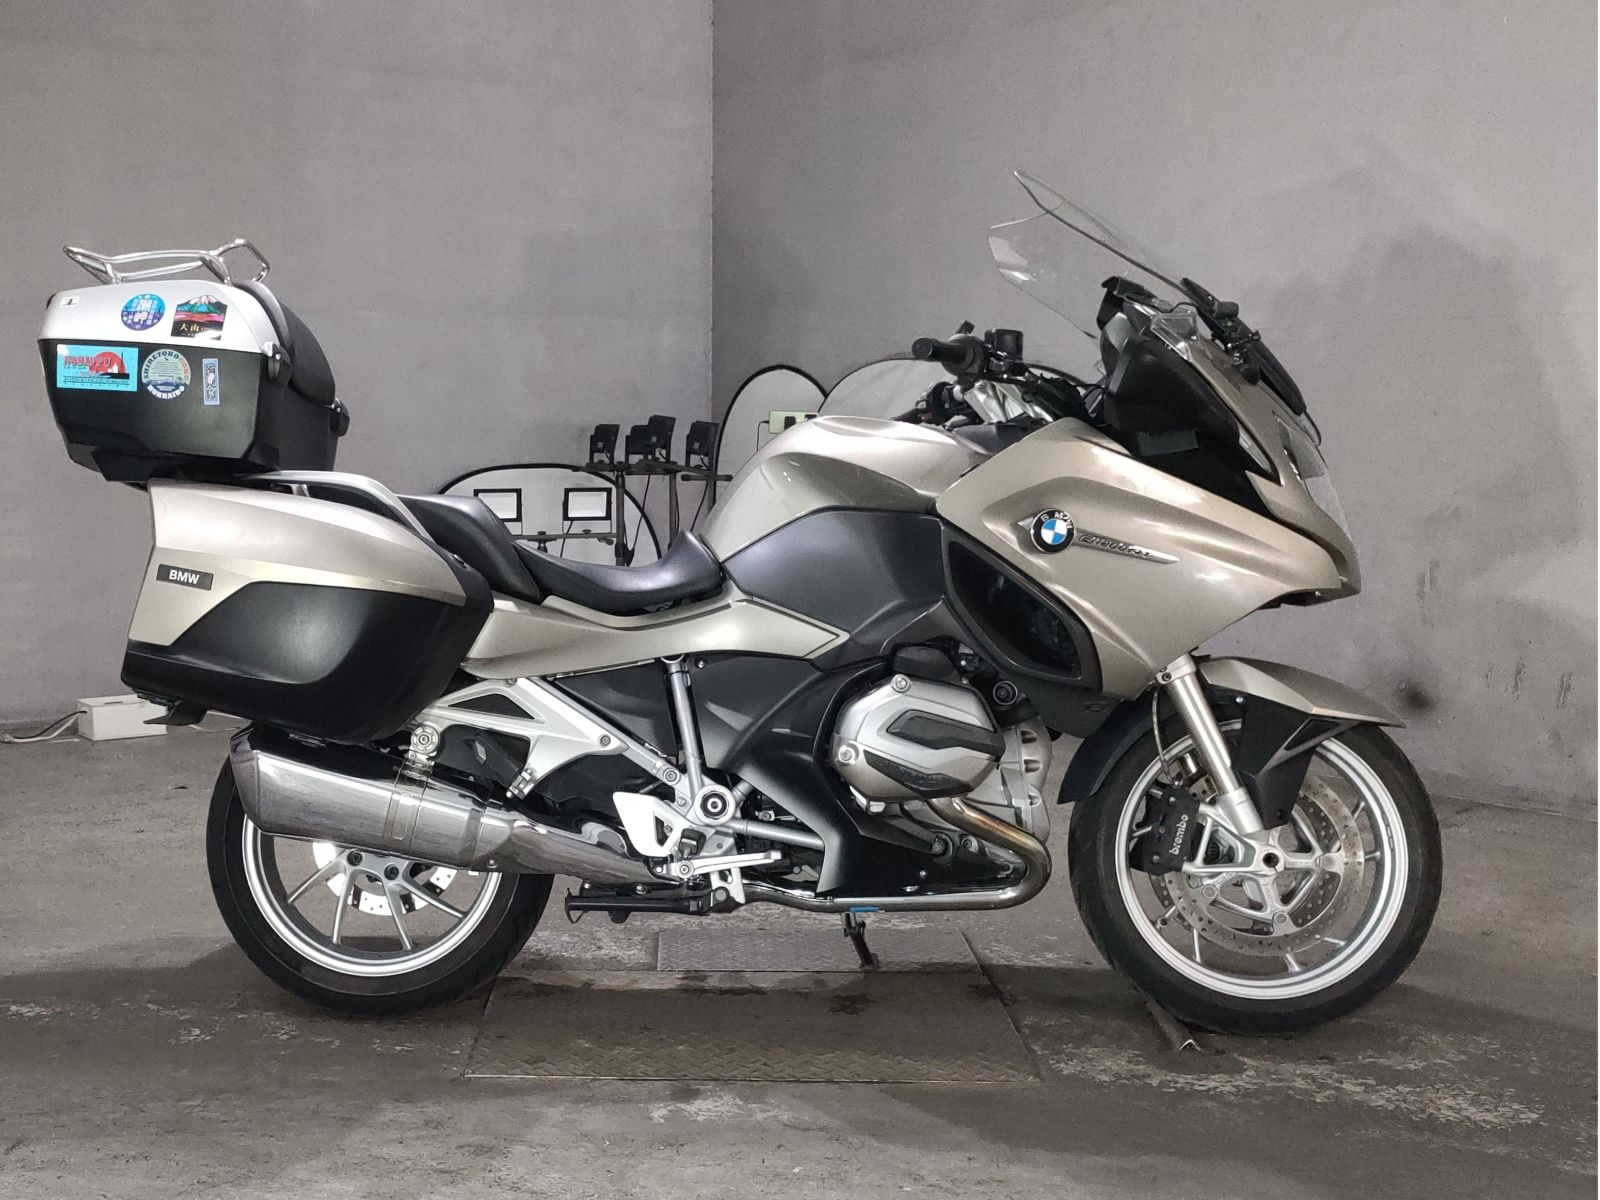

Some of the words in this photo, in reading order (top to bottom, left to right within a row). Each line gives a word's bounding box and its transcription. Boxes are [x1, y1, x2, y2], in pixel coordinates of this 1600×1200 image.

[143, 351, 180, 379] SHIRETOKO
[147, 384, 185, 399] HOKKAIDO
[1040, 511, 1073, 529] BMW
[169, 569, 200, 585] BMW
[1168, 814, 1189, 855] brembo
